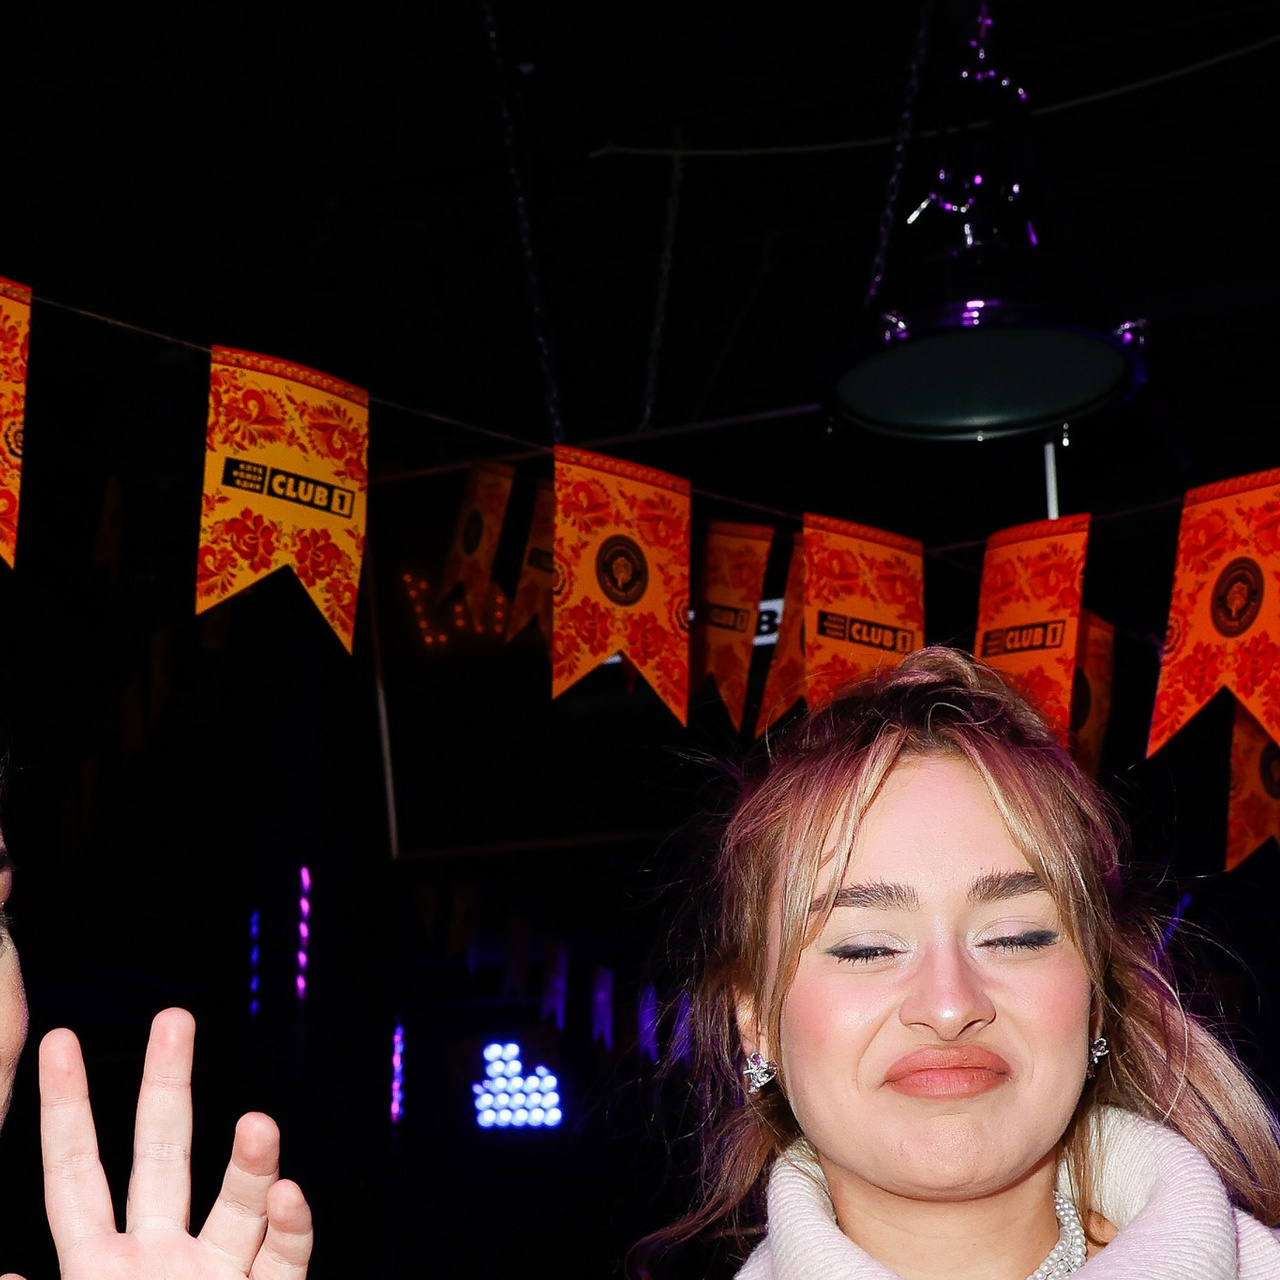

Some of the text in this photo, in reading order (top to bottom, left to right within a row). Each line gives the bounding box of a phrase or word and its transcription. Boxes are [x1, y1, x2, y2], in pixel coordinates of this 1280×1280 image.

[271, 473, 329, 507] CLUB
[851, 622, 894, 648] CLUB
[1005, 626, 1045, 651] CLUB
